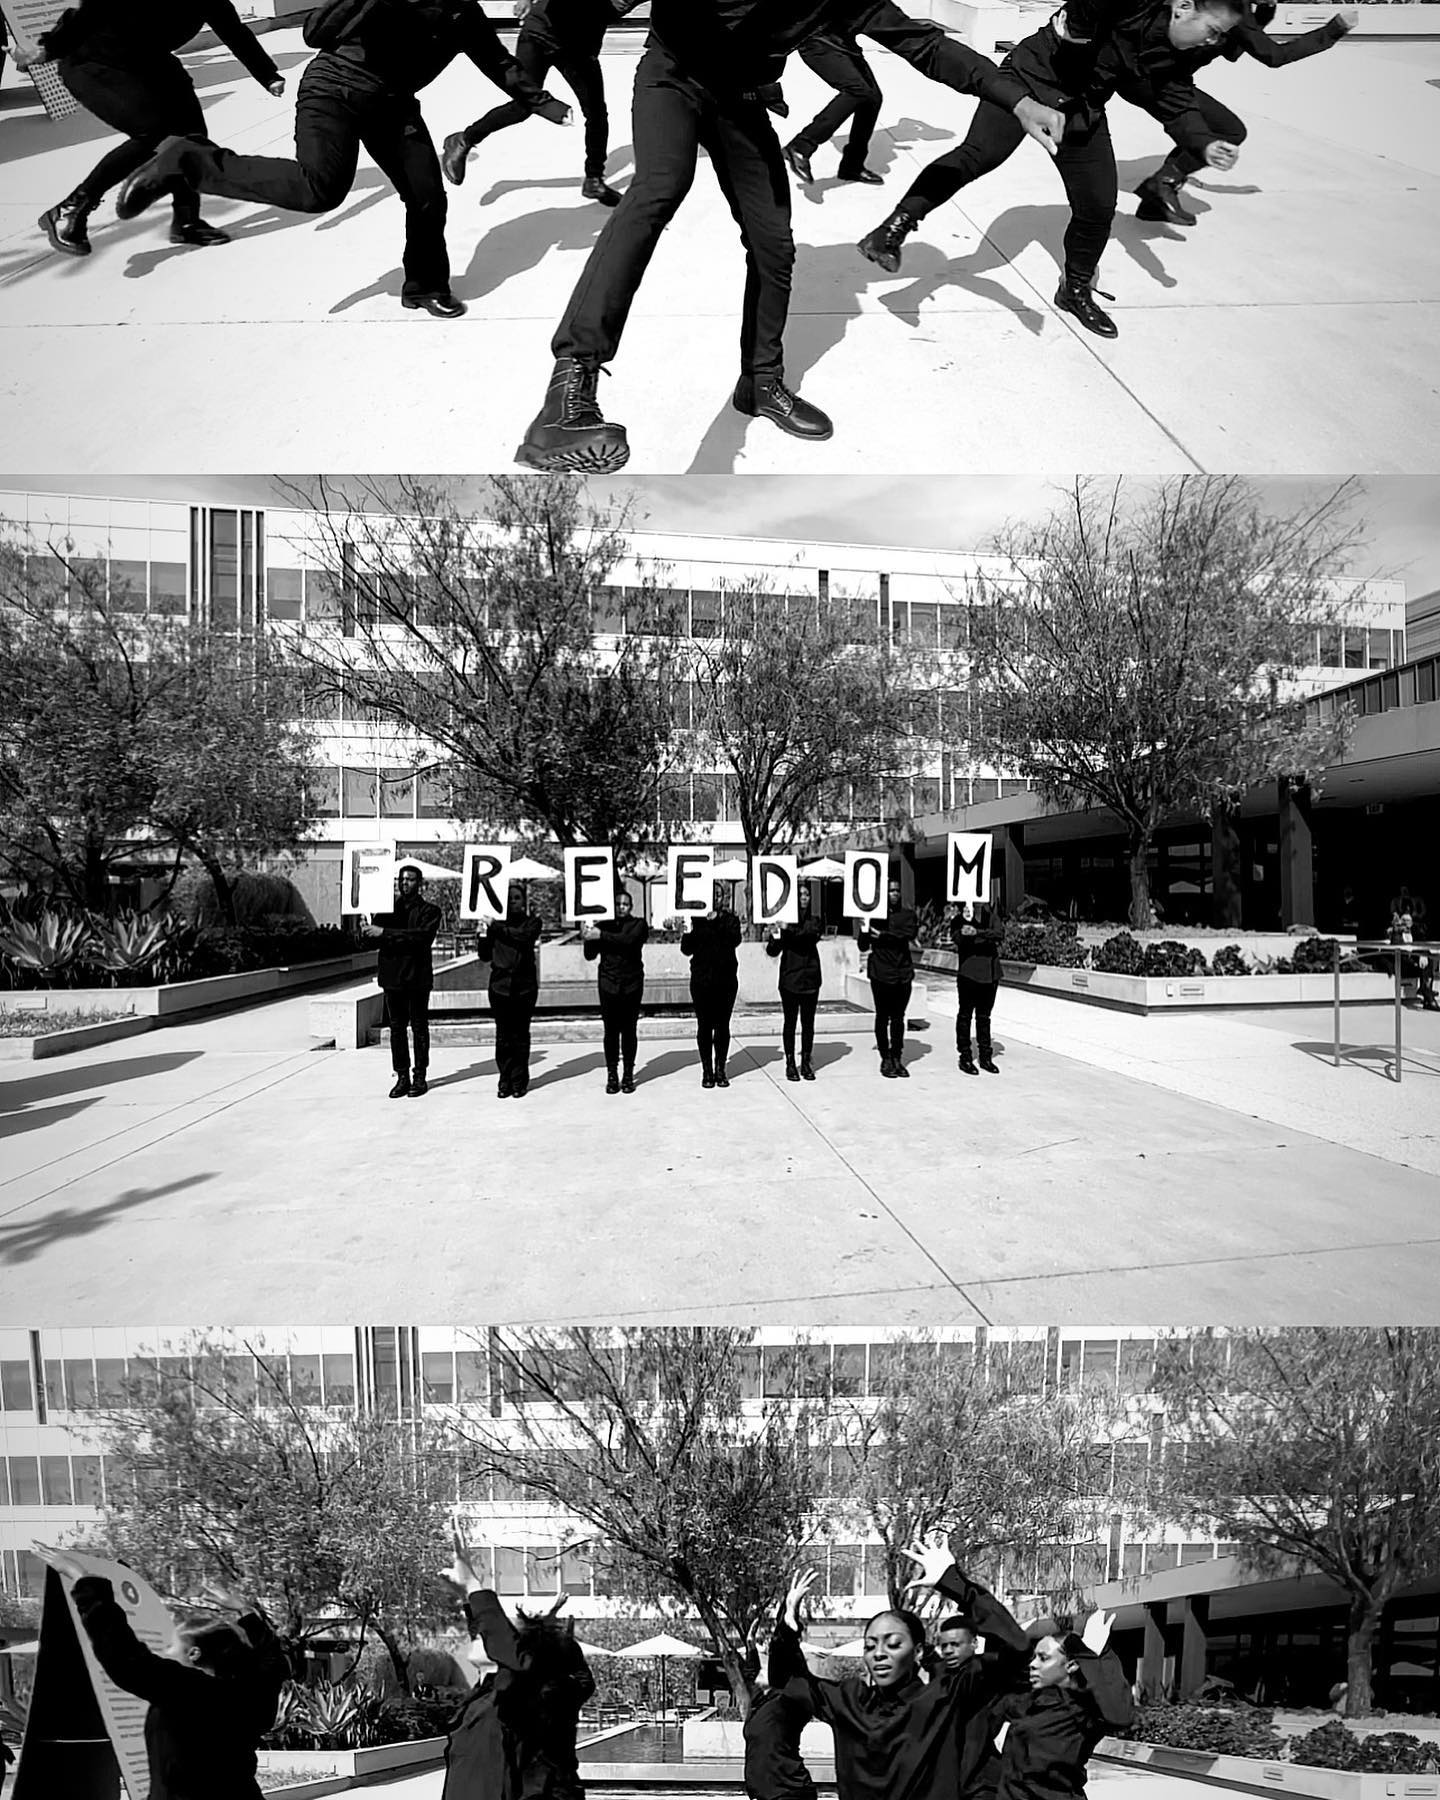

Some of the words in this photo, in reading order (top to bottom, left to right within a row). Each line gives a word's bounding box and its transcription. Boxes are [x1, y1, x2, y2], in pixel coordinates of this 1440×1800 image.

[351, 848, 391, 908] F
[469, 855, 504, 914] R
[574, 856, 608, 916] E
[675, 855, 710, 910] E
[760, 862, 791, 918] D
[853, 857, 882, 912] O
[952, 841, 987, 897] M
